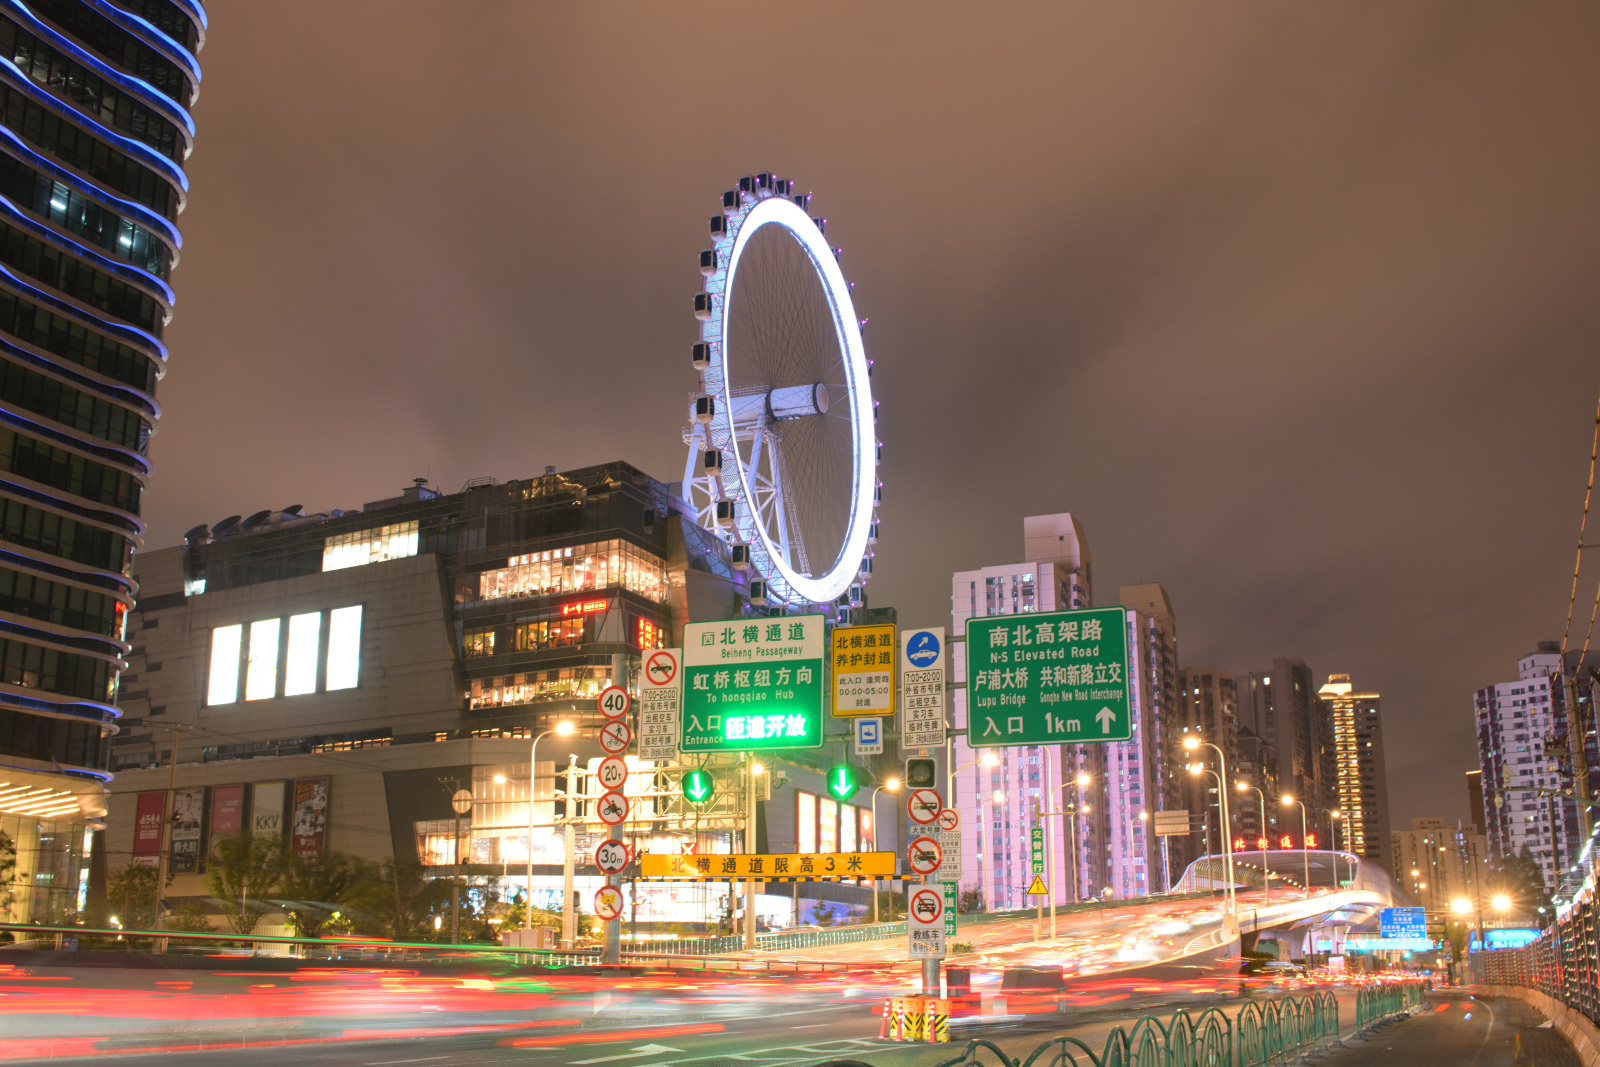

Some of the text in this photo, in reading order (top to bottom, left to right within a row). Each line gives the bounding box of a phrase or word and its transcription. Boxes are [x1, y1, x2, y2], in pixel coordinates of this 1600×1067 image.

[720, 622, 805, 644] 北横通道
[989, 619, 1102, 648] 南北高架路
[836, 634, 892, 649] 北横通道
[722, 646, 803, 659] Beiheng Passageway
[836, 651, 892, 668] 养护封道
[990, 645, 1099, 663] N-S Elevated Road
[693, 666, 812, 690] 虹桥枢纽方向
[975, 662, 1122, 691] 卢浦大桥 共和新路立交
[707, 689, 794, 704] To hongqiao Hub
[906, 684, 941, 695] 外省市号牌
[1062, 691, 1072, 702] New
[1075, 690, 1088, 700] Road
[1090, 688, 1123, 702] Interchange
[604, 694, 623, 711] 40
[643, 700, 676, 711] 外省市号牌
[909, 696, 938, 707] 出租空车
[978, 694, 1026, 708] Lupu Bridge
[913, 709, 934, 719] 实习车
[649, 725, 668, 734] 实习车
[687, 714, 721, 733] 入口
[909, 721, 938, 731] 临时号牌
[982, 716, 1023, 736] 入口
[1045, 712, 1081, 734] 1km
[686, 735, 723, 745] Entrance
[256, 815, 279, 830] KKV
[913, 826, 940, 834] 大型号牌
[1235, 834, 1317, 849] 北横通道
[1033, 830, 1042, 872] 交替通行
[672, 856, 862, 874] 北横通道限高3米
[944, 884, 955, 934] 车道合并
[913, 930, 940, 940] 教练车
